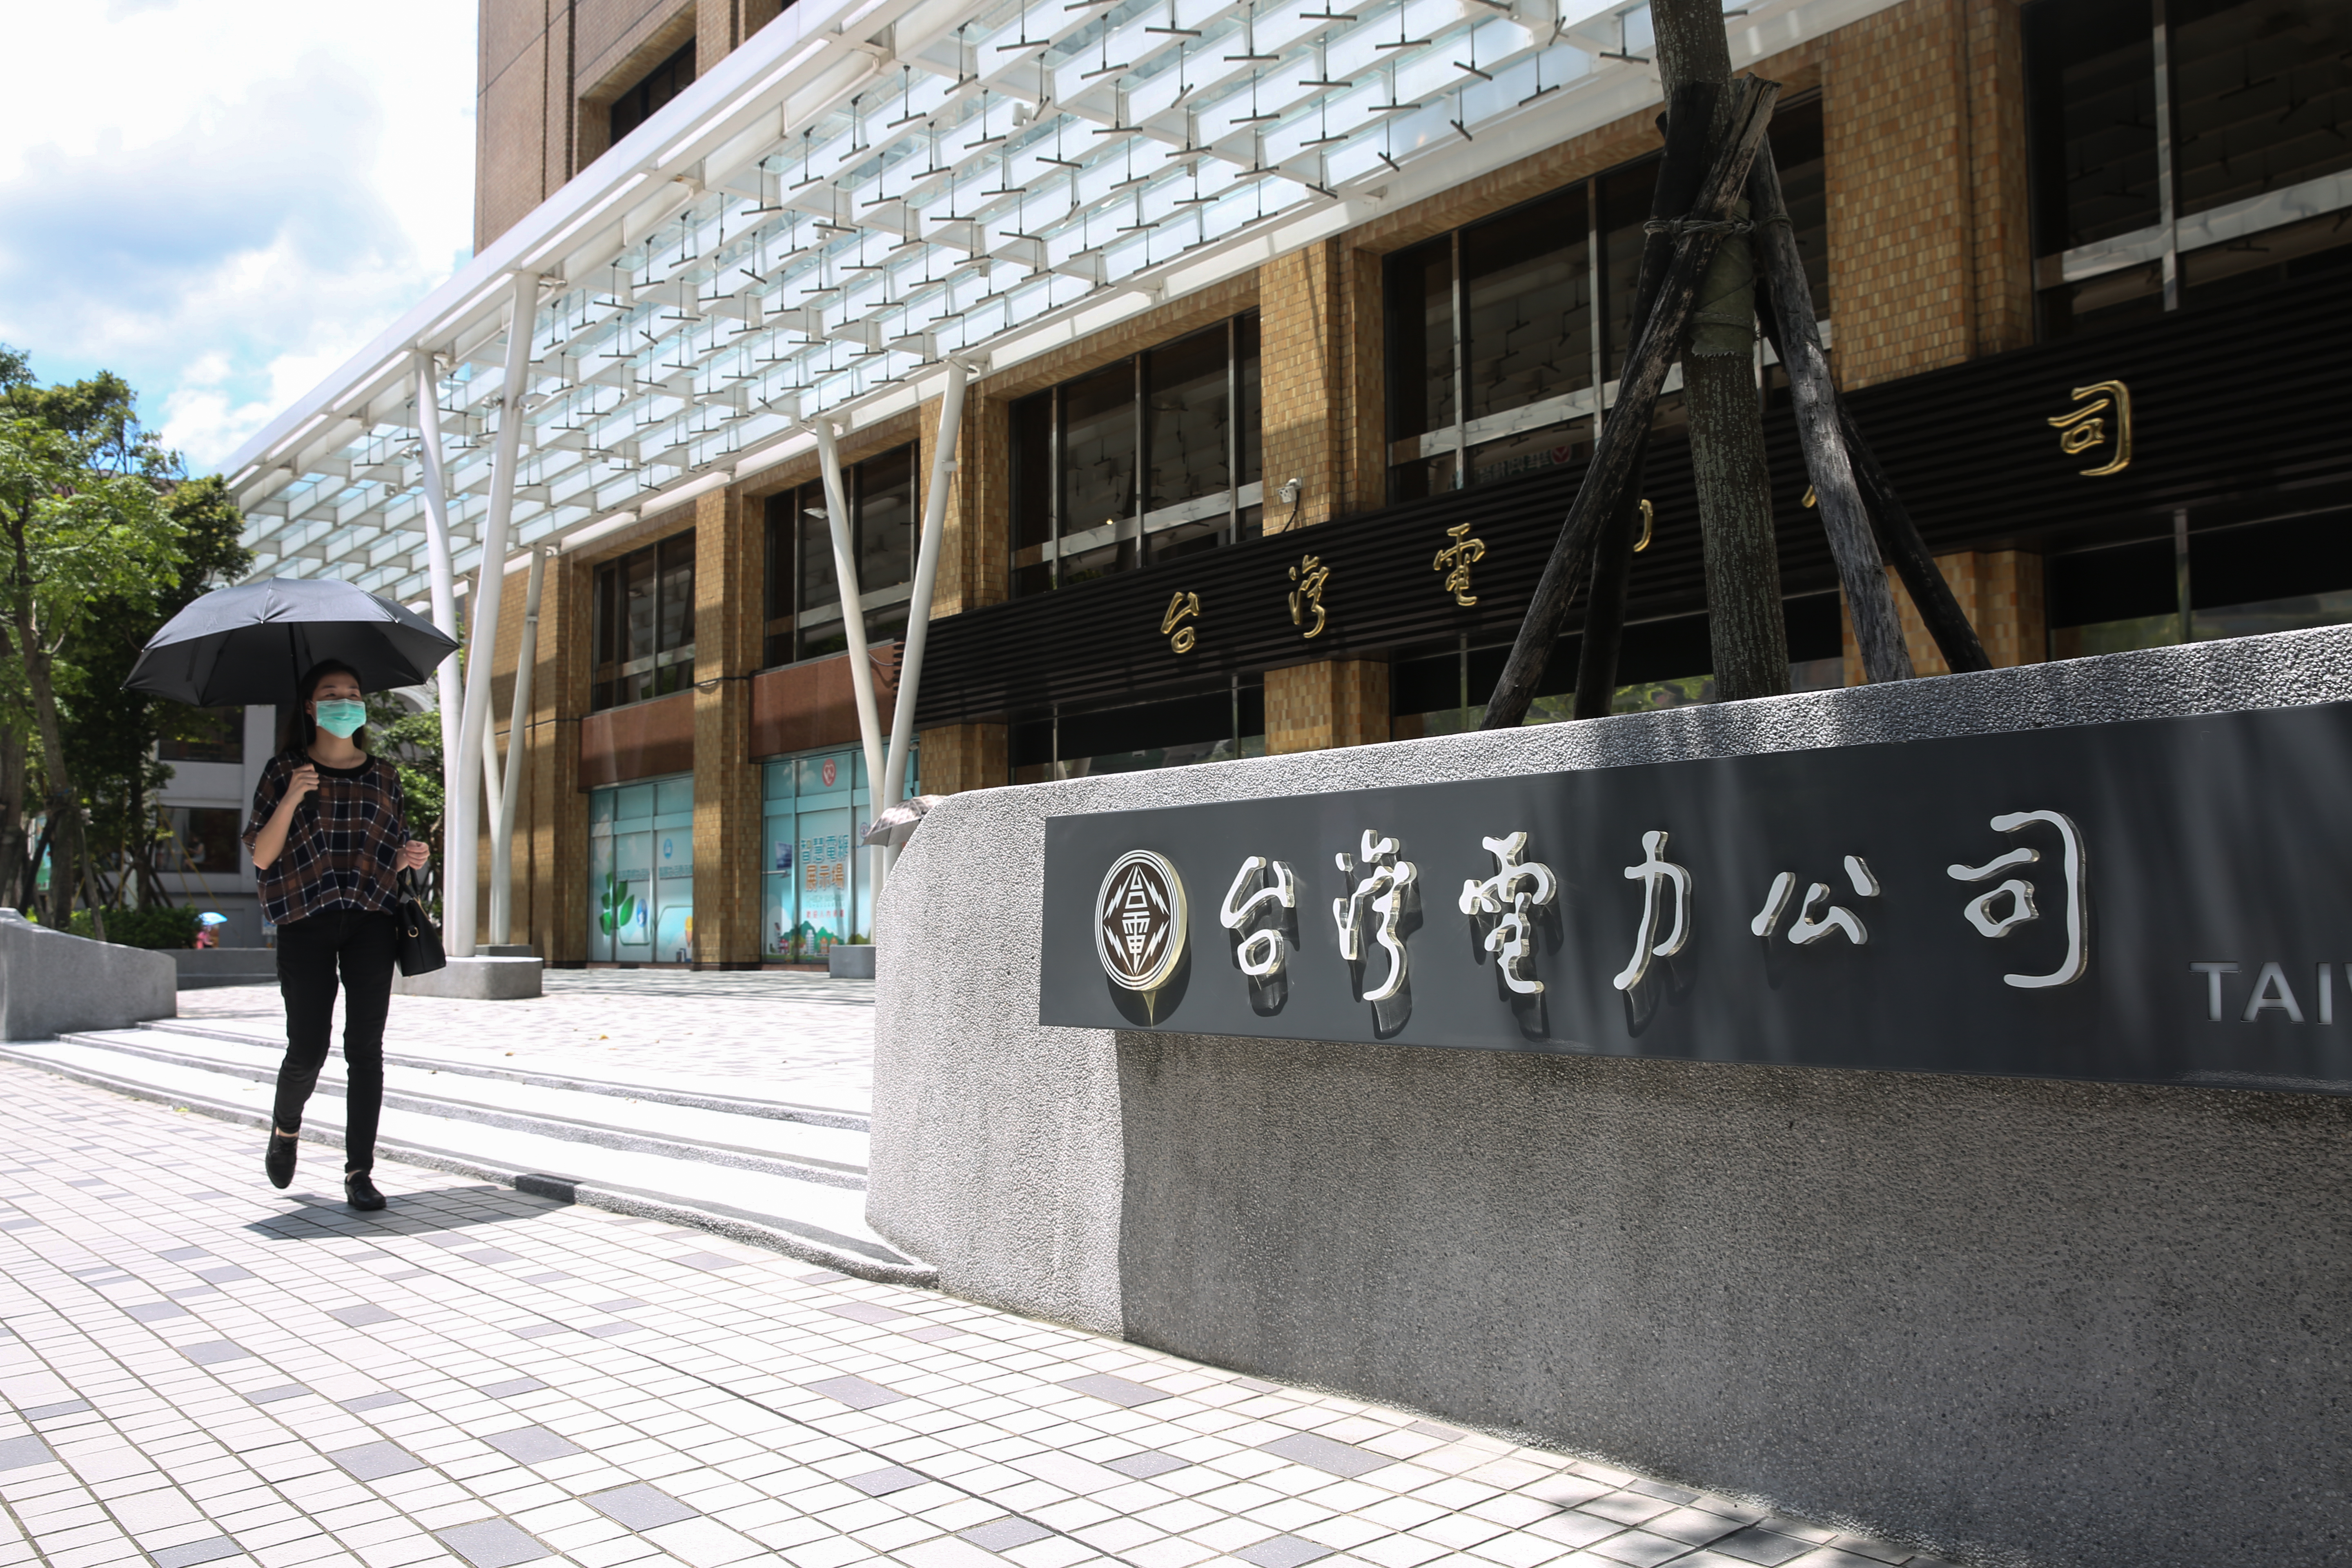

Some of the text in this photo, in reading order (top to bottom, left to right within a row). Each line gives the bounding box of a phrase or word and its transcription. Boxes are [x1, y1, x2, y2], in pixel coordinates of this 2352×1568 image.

[1160, 380, 2131, 653] 台灣電司
[801, 834, 849, 863] 智慧電網
[806, 863, 844, 891] 展示場
[1220, 810, 2088, 1000] 台灣電力公司
[2189, 962, 2352, 1025] TAI
